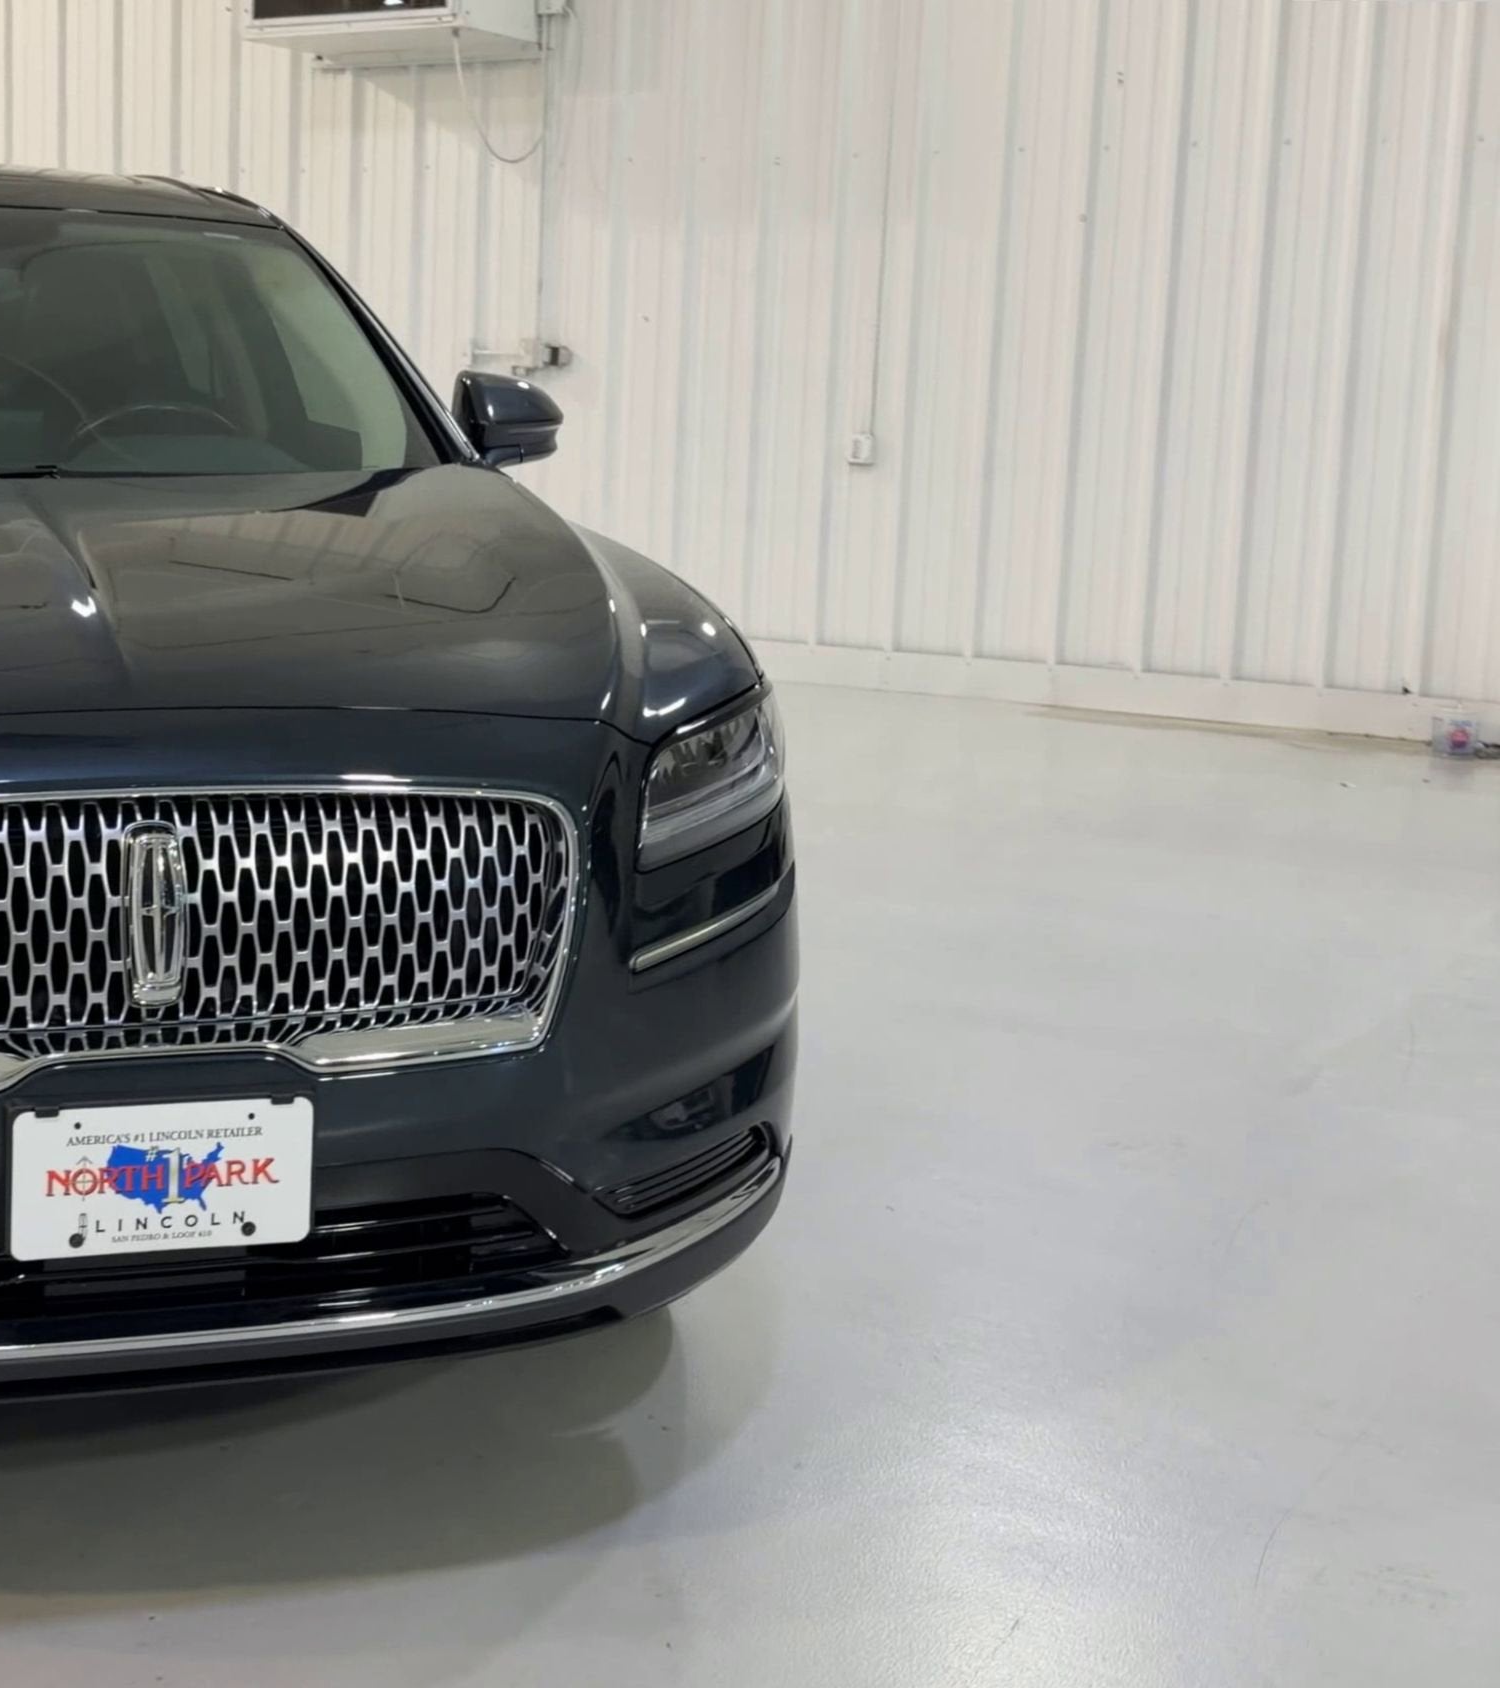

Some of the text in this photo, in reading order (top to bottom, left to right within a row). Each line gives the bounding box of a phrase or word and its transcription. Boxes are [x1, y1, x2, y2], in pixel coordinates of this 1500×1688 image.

[133, 1132, 145, 1142] #1
[149, 1128, 204, 1142] LINCOLN
[206, 1126, 263, 1139] RETAILER
[45, 1157, 280, 1198] NORTH PARK
[95, 1210, 246, 1233] LINCOLN
